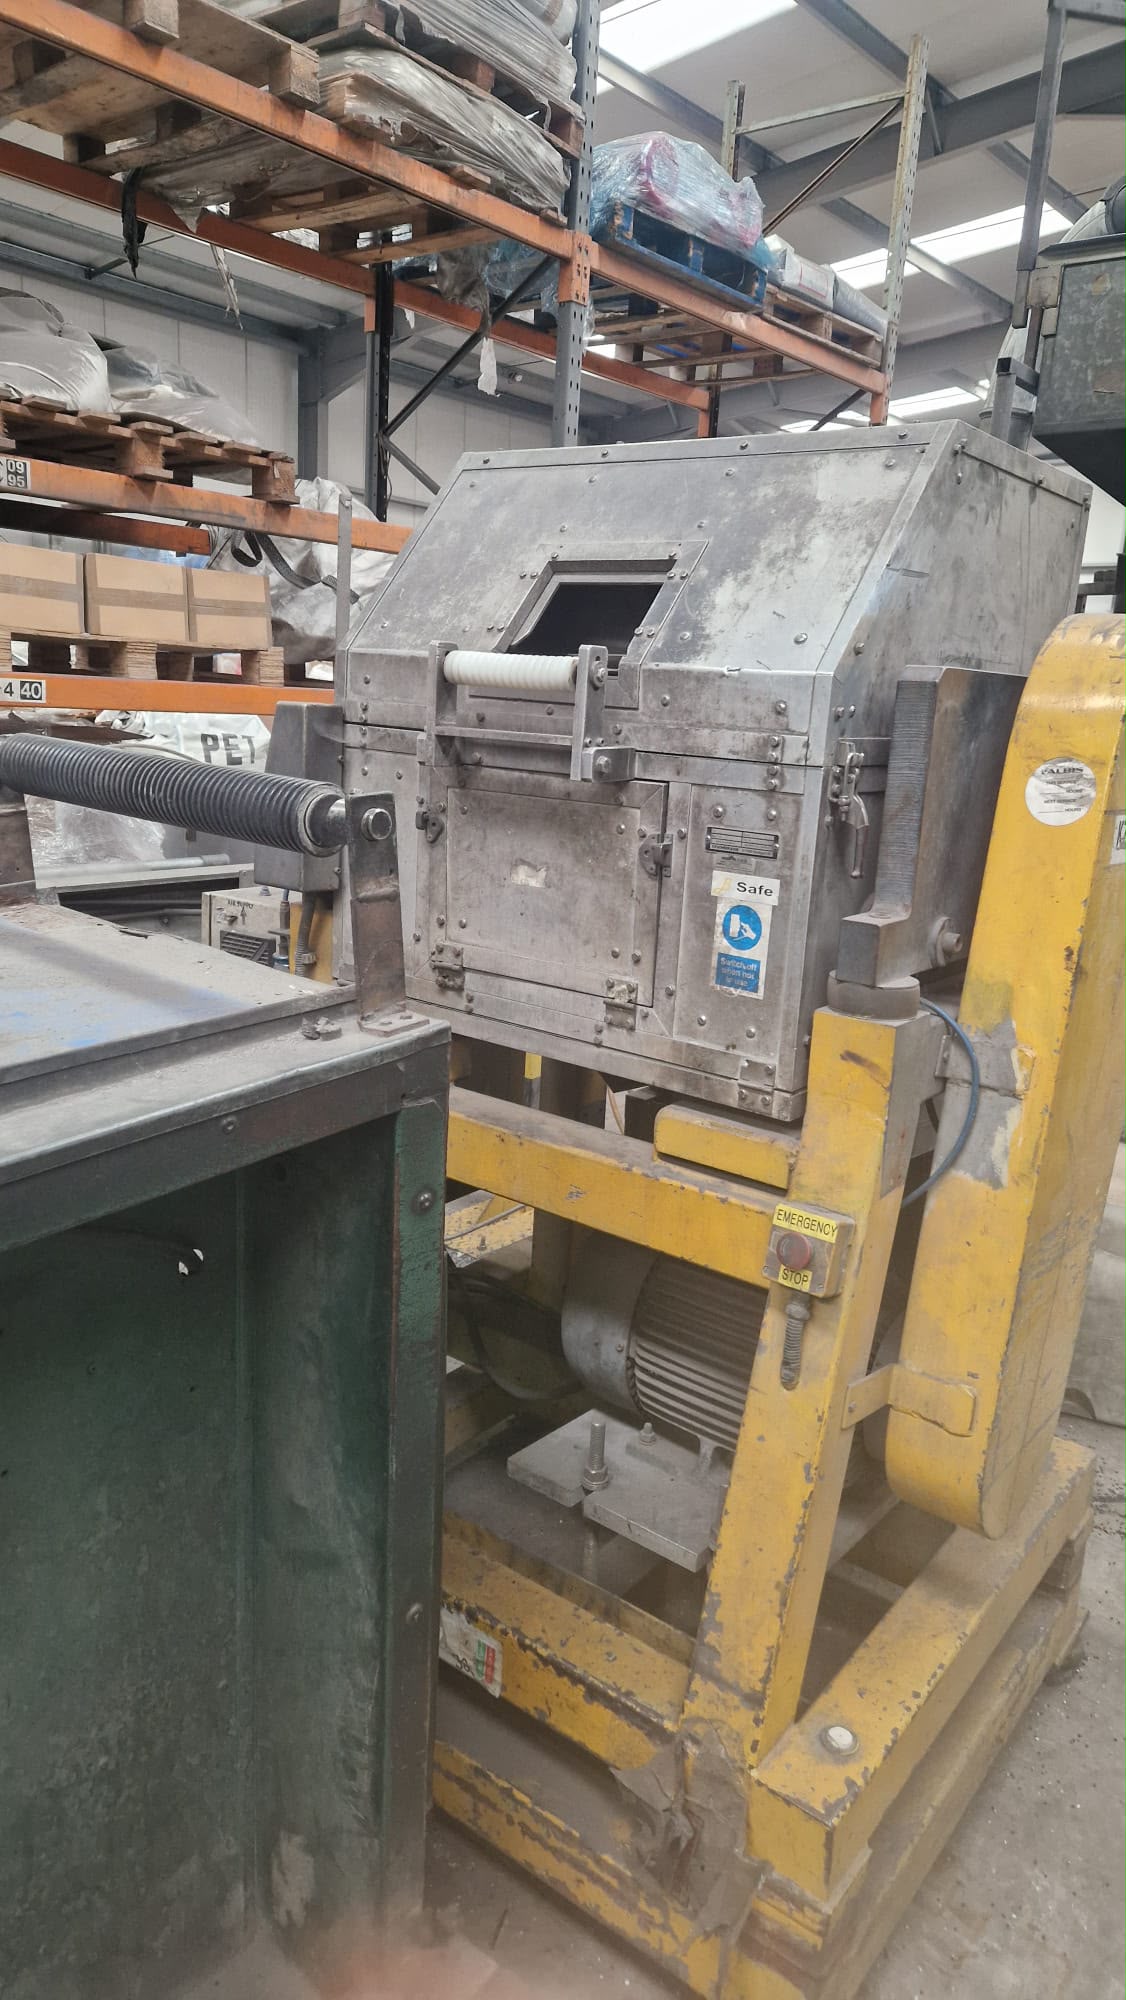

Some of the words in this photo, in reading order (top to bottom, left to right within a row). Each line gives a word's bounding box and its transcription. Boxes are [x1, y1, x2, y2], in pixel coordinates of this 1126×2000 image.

[7, 460, 25, 474] 09
[7, 474, 25, 488] 95
[20, 682, 42, 699] 40
[200, 733, 256, 766] PET
[736, 881, 774, 897] Safe
[776, 1208, 839, 1238] EMERGENCY
[782, 1268, 809, 1286] STOP
